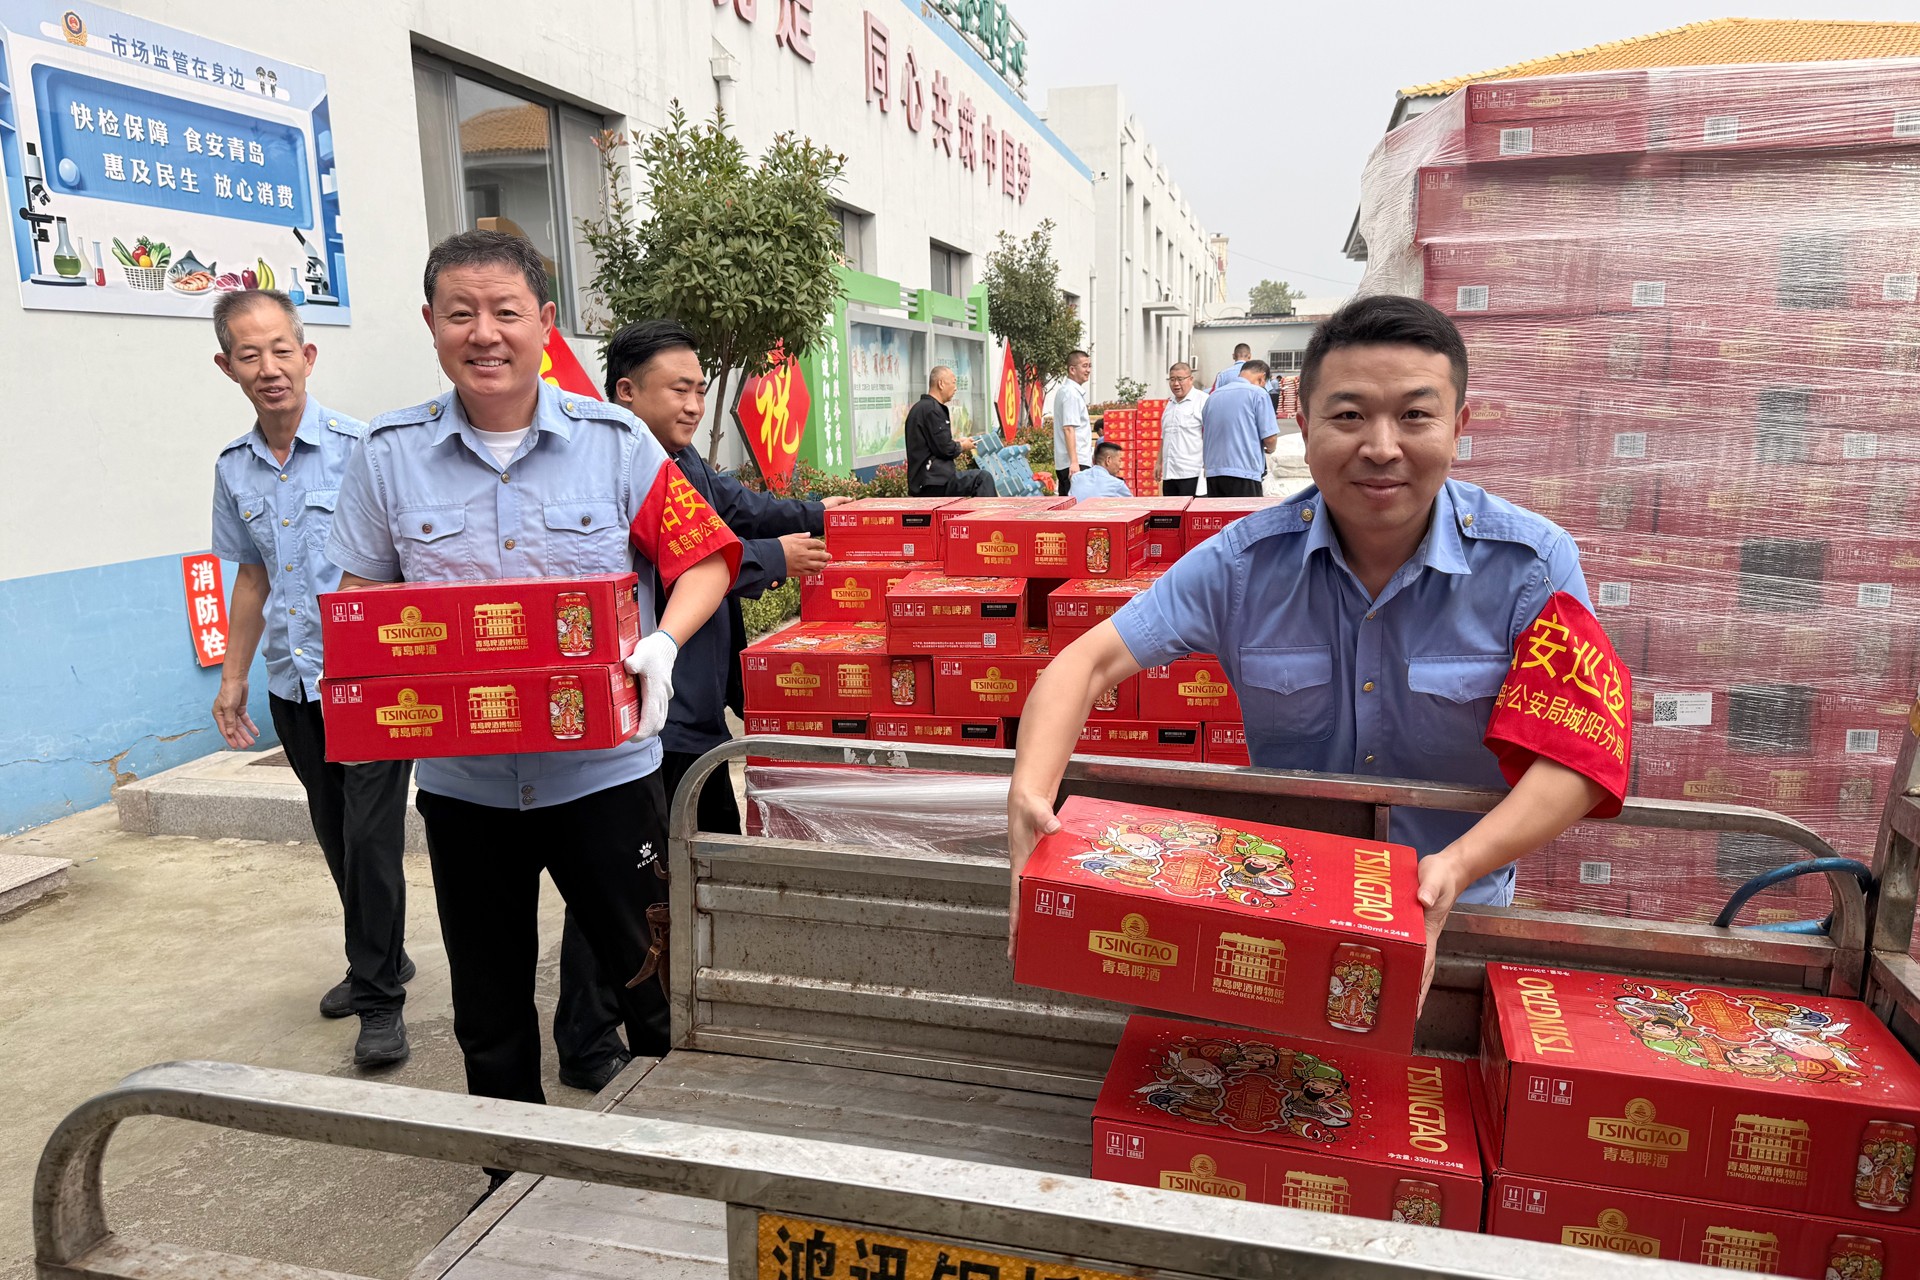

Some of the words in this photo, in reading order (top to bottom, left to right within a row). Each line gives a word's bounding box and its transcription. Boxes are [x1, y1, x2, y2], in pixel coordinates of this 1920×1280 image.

[109, 33, 246, 91] 市场监管在身边
[863, 10, 1031, 205] 同心共筑中国梦
[70, 101, 170, 147] 快检保障
[183, 127, 265, 167] 食安青岛
[102, 152, 200, 194] 惠及民生
[213, 173, 295, 210] 放心消费
[979, 544, 1016, 553] TSINGTAO
[834, 590, 869, 598] TSINGTAO
[190, 560, 227, 659] 消防栓
[382, 626, 443, 640] TSINGTAO
[779, 676, 818, 685] TSINGTAO
[1511, 613, 1626, 729] 安巡逻
[973, 680, 1015, 690] TSINGTAO
[1181, 684, 1225, 694] TSINGTAO
[380, 708, 439, 721] TSINGTAO
[1353, 848, 1394, 922] TSINGTAO
[1095, 935, 1172, 961] TSINGTAO
[1516, 976, 1575, 1056] TSINGTAO
[1407, 1066, 1449, 1153] TSINGTAO
[1595, 1121, 1682, 1147] TSINGTAO
[1165, 1175, 1241, 1199] TSINGTAO
[1568, 1230, 1654, 1256] TSINGTAO
